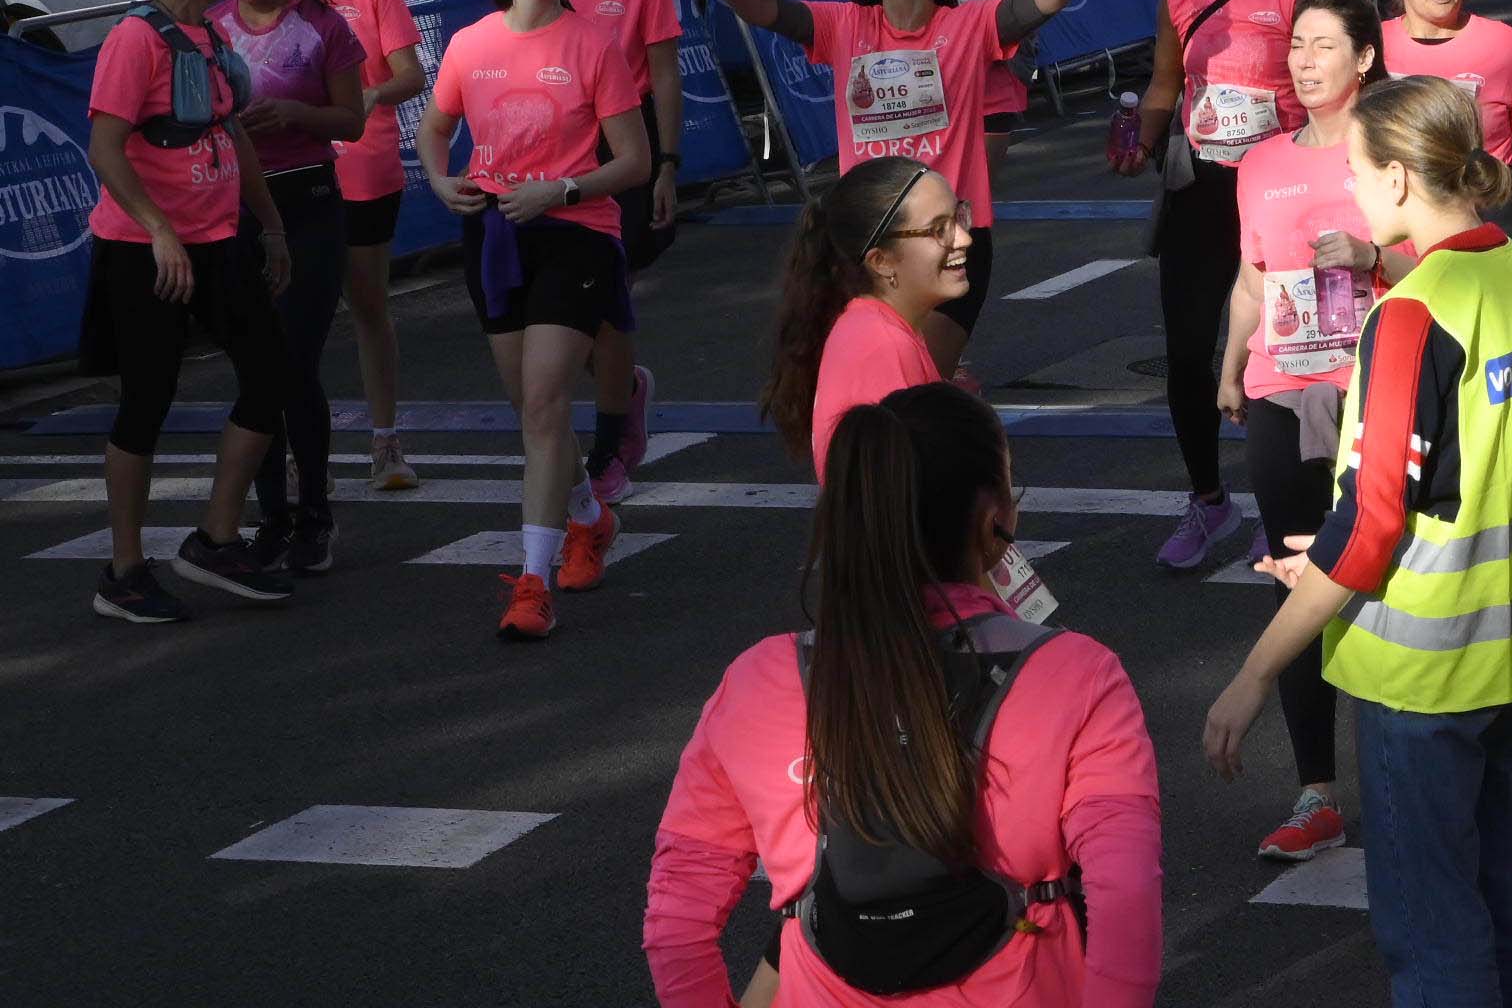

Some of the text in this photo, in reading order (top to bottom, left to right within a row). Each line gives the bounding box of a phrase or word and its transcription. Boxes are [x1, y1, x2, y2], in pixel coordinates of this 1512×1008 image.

[472, 69, 508, 80] OYSHO
[876, 85, 908, 99] 016
[882, 101, 907, 111] 18748
[1221, 112, 1248, 127] 016
[861, 126, 888, 135] OYSHO
[1226, 128, 1246, 138] 8750
[475, 145, 493, 165] TU
[1263, 183, 1308, 201] OYSHO
